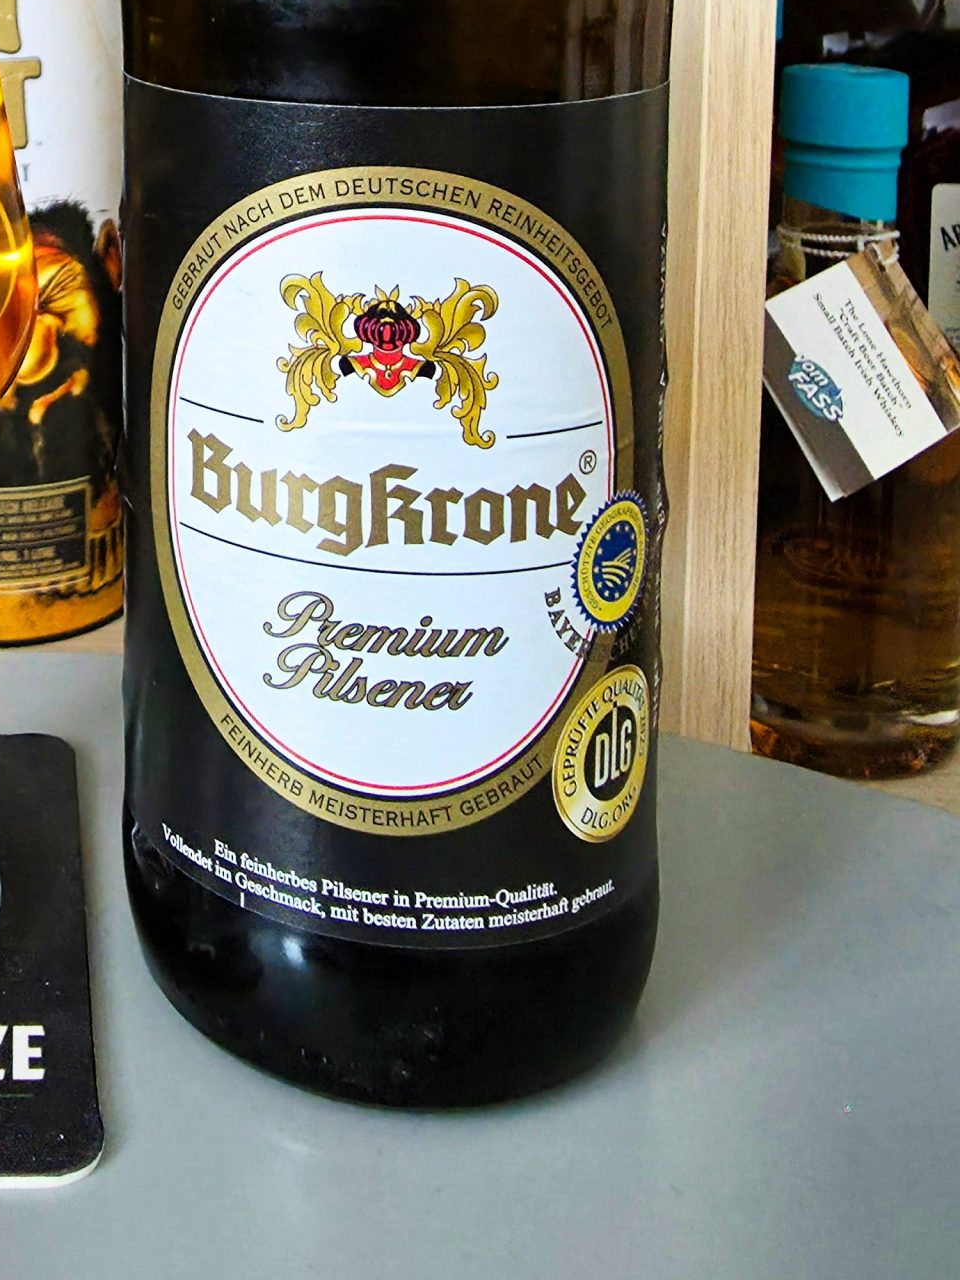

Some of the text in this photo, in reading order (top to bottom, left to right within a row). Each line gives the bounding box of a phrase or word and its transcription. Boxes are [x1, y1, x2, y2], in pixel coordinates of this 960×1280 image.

[172, 176, 613, 330] GEBRAUT NACH DEM DEUTSCHEN REINHEITSGEBOT
[788, 371, 844, 422] FASS
[263, 591, 509, 658] Premium
[263, 643, 474, 712] Pilsener
[219, 713, 544, 829] FEINHERB MEISTERHAFT GEBRAUT
[563, 696, 601, 797] GEPRÜFTE
[594, 701, 633, 788] DLG
[161, 822, 616, 930] Vollendet im Geschmack, mit besten Zutaten meisterhaft gebraut.
[214, 838, 557, 909] Ein feinherbes Pilsener in Premium-Qualität.
